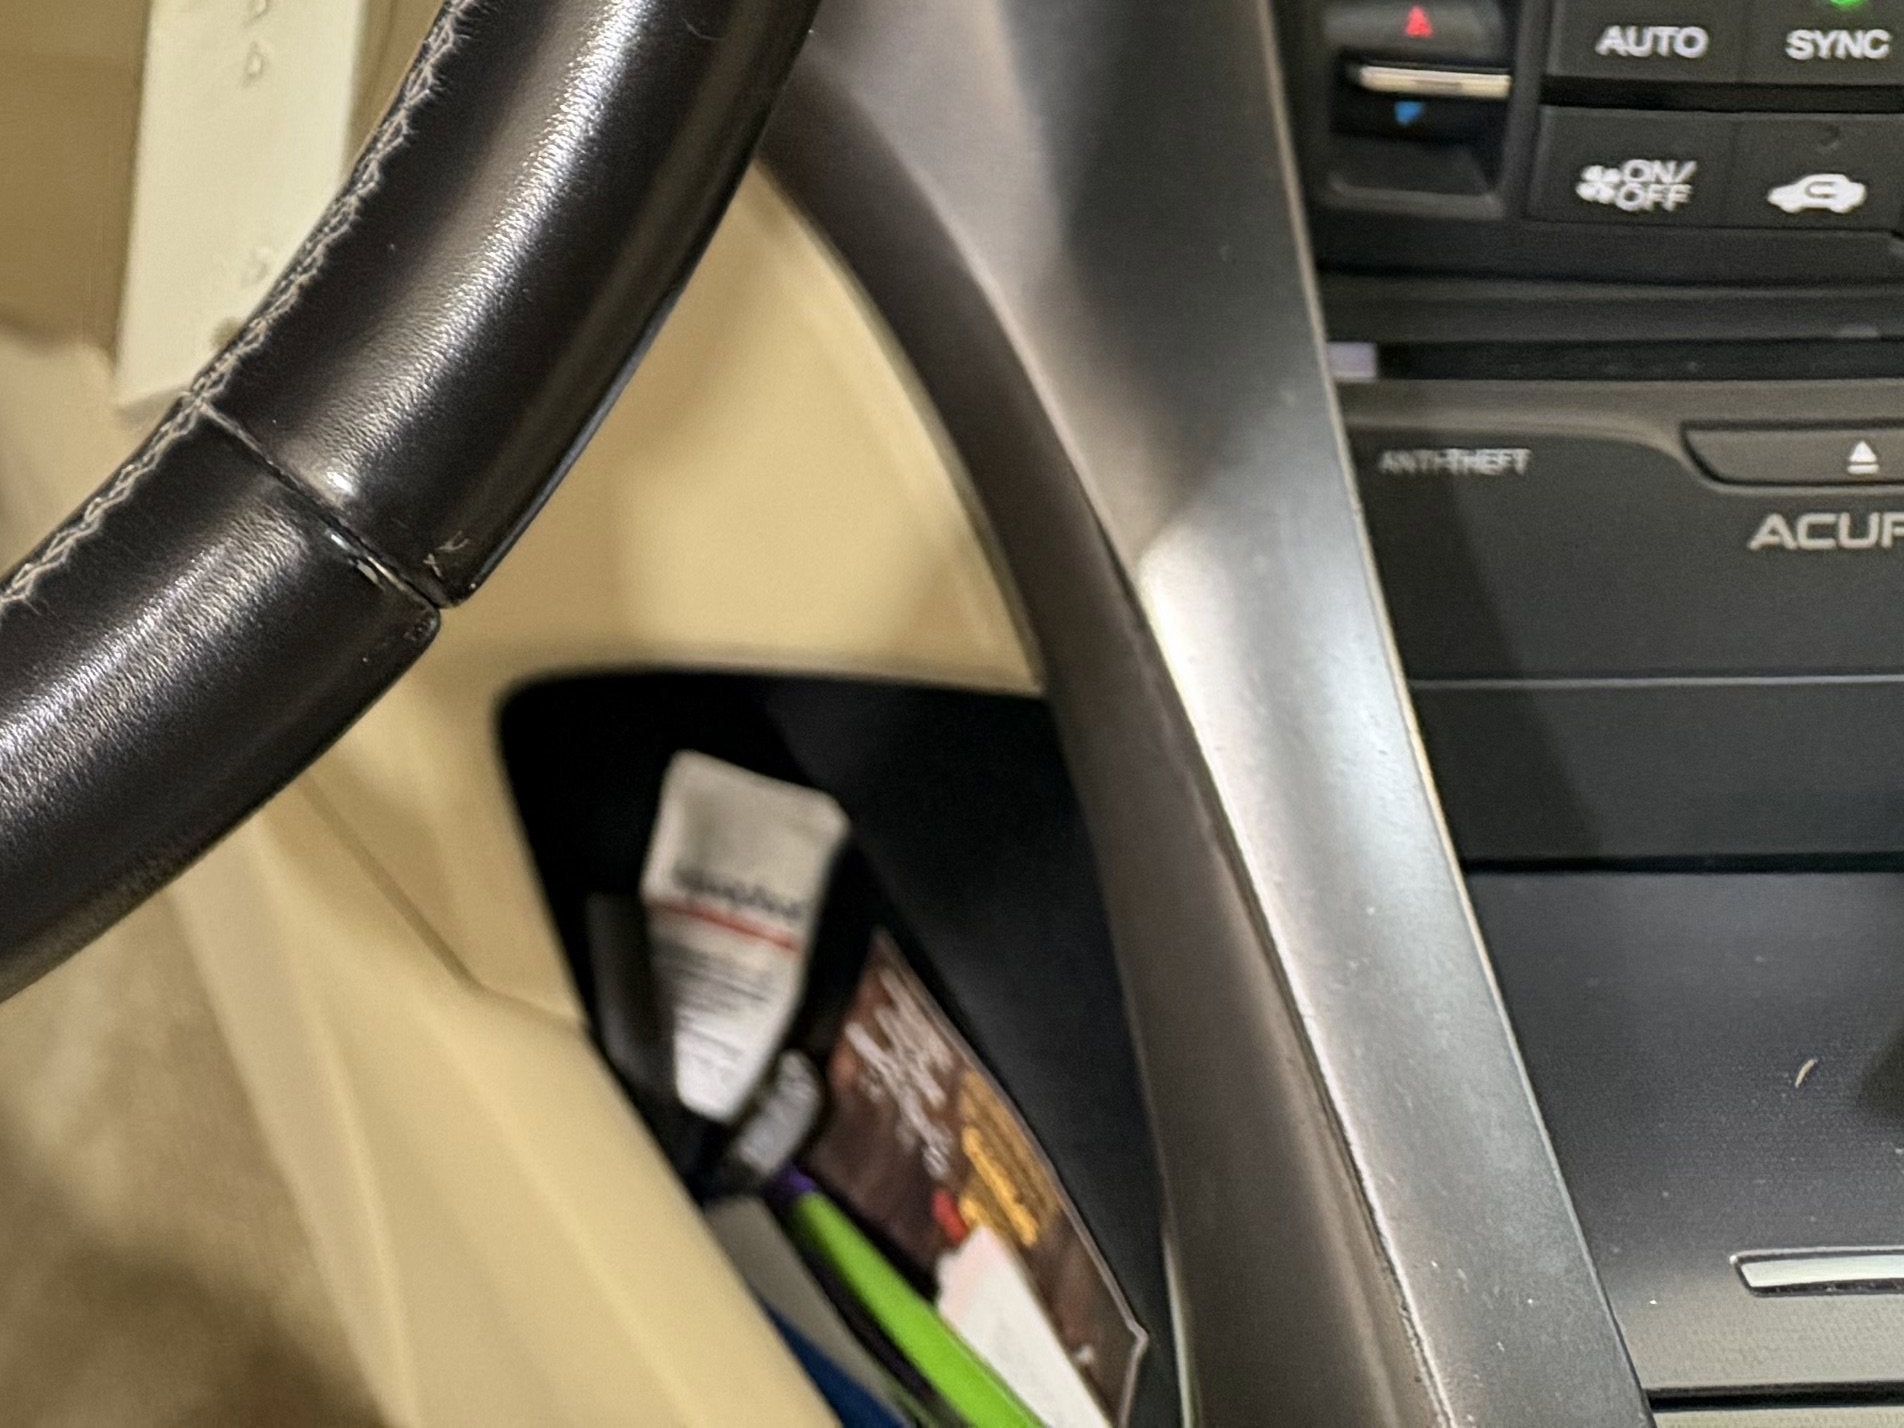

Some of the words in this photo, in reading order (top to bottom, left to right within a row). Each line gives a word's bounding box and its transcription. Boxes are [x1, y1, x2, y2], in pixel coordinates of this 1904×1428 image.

[1596, 25, 1709, 59] AUTO
[1786, 29, 1891, 61] SYNC
[1624, 158, 1697, 185] ON/
[1616, 184, 1691, 212] OFF
